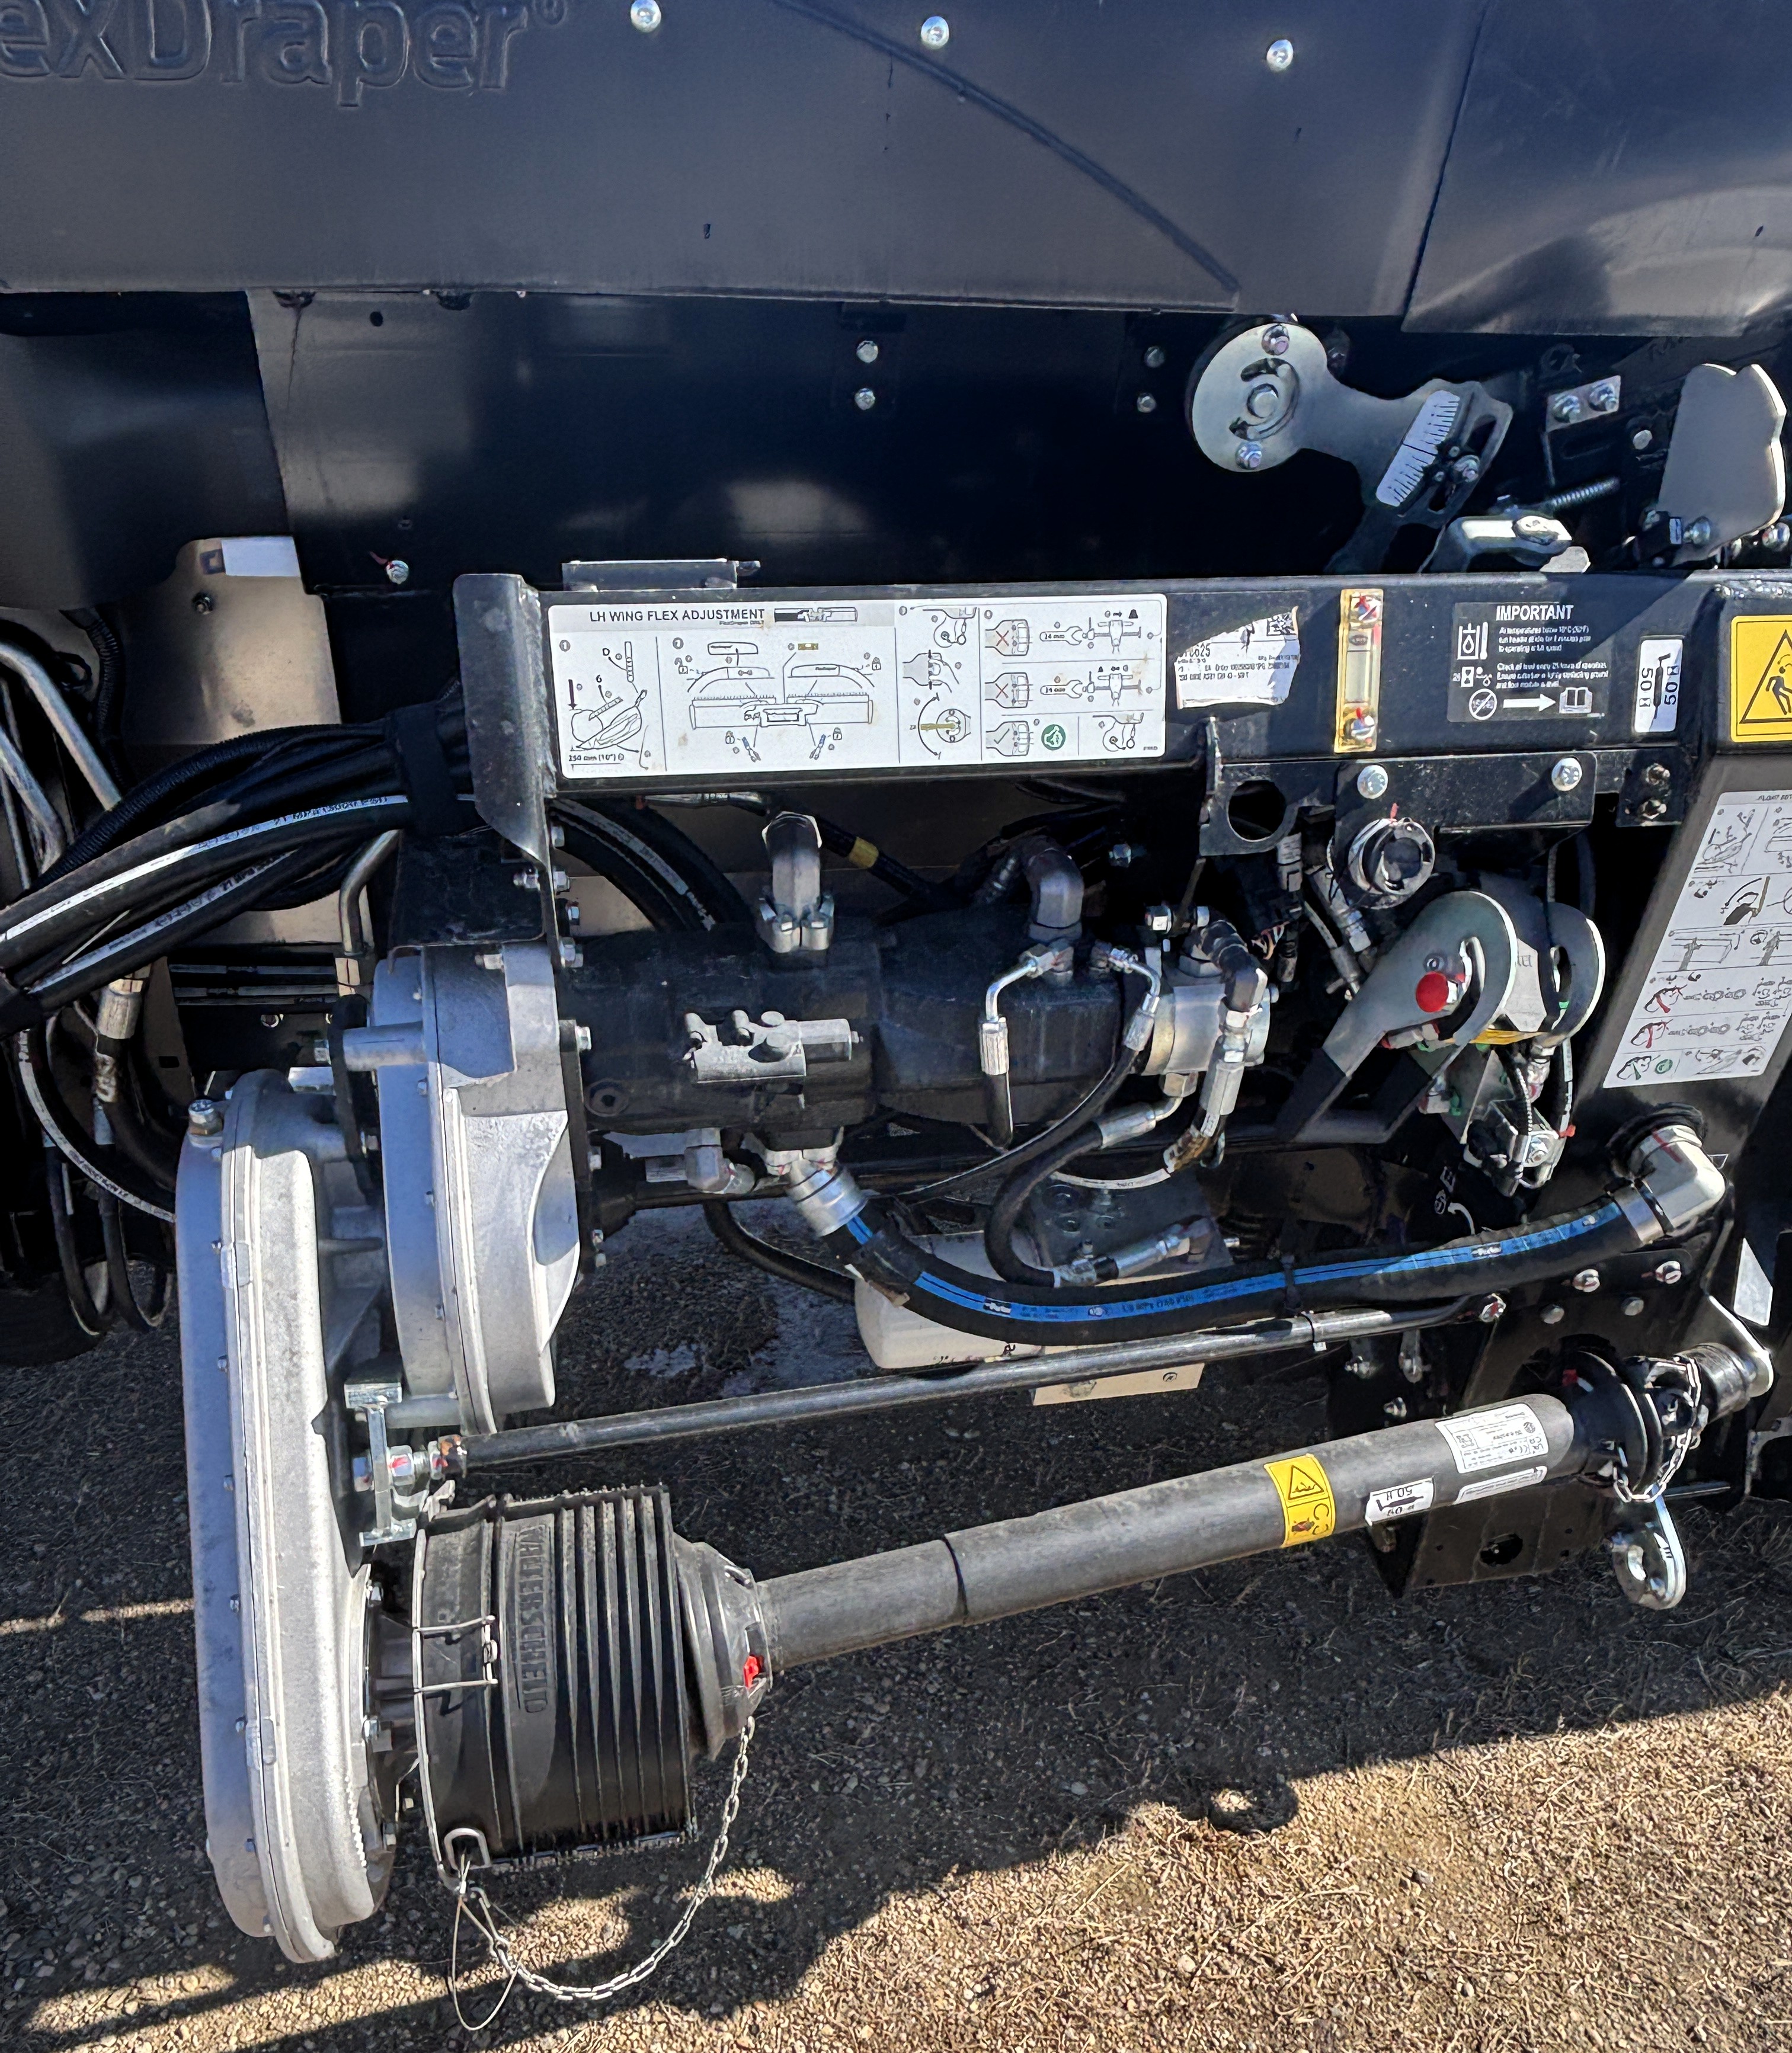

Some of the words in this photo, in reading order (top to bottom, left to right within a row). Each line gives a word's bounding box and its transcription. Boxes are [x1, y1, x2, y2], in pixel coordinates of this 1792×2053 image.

[590, 611, 606, 622] LH
[610, 611, 643, 622] WING
[648, 610, 678, 621] FLEX
[682, 608, 765, 621] ADJUSTMENT
[1496, 604, 1574, 621] IMPORTANT
[1640, 667, 1653, 691] 50
[1664, 681, 1678, 705] 50
